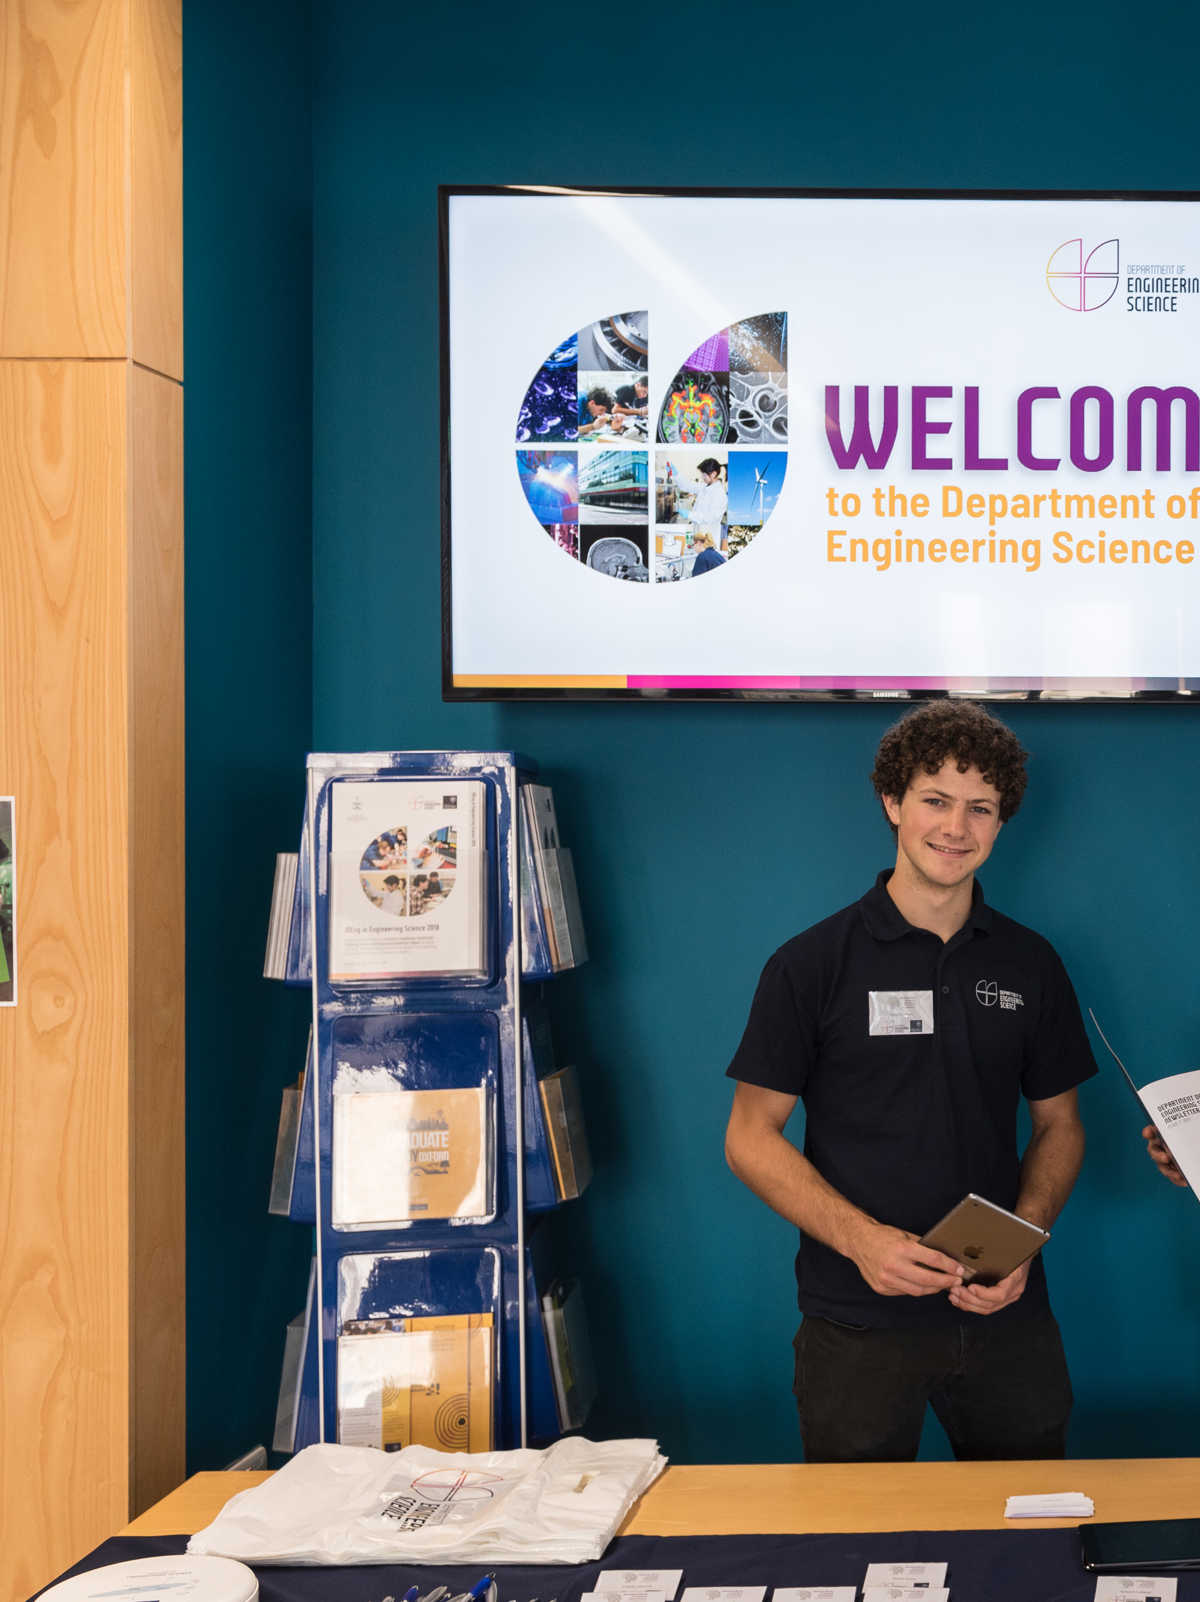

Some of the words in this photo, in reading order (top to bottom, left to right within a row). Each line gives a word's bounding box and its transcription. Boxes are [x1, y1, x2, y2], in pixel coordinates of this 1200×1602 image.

[1126, 264, 1175, 275] DEPARTMENT
[1178, 264, 1187, 275] OF
[1127, 296, 1177, 312] SCIENCE
[826, 488, 861, 517] to
[872, 485, 930, 517] the
[942, 486, 1155, 526] Department
[827, 525, 1040, 572] Engineering
[1053, 530, 1194, 564] Science
